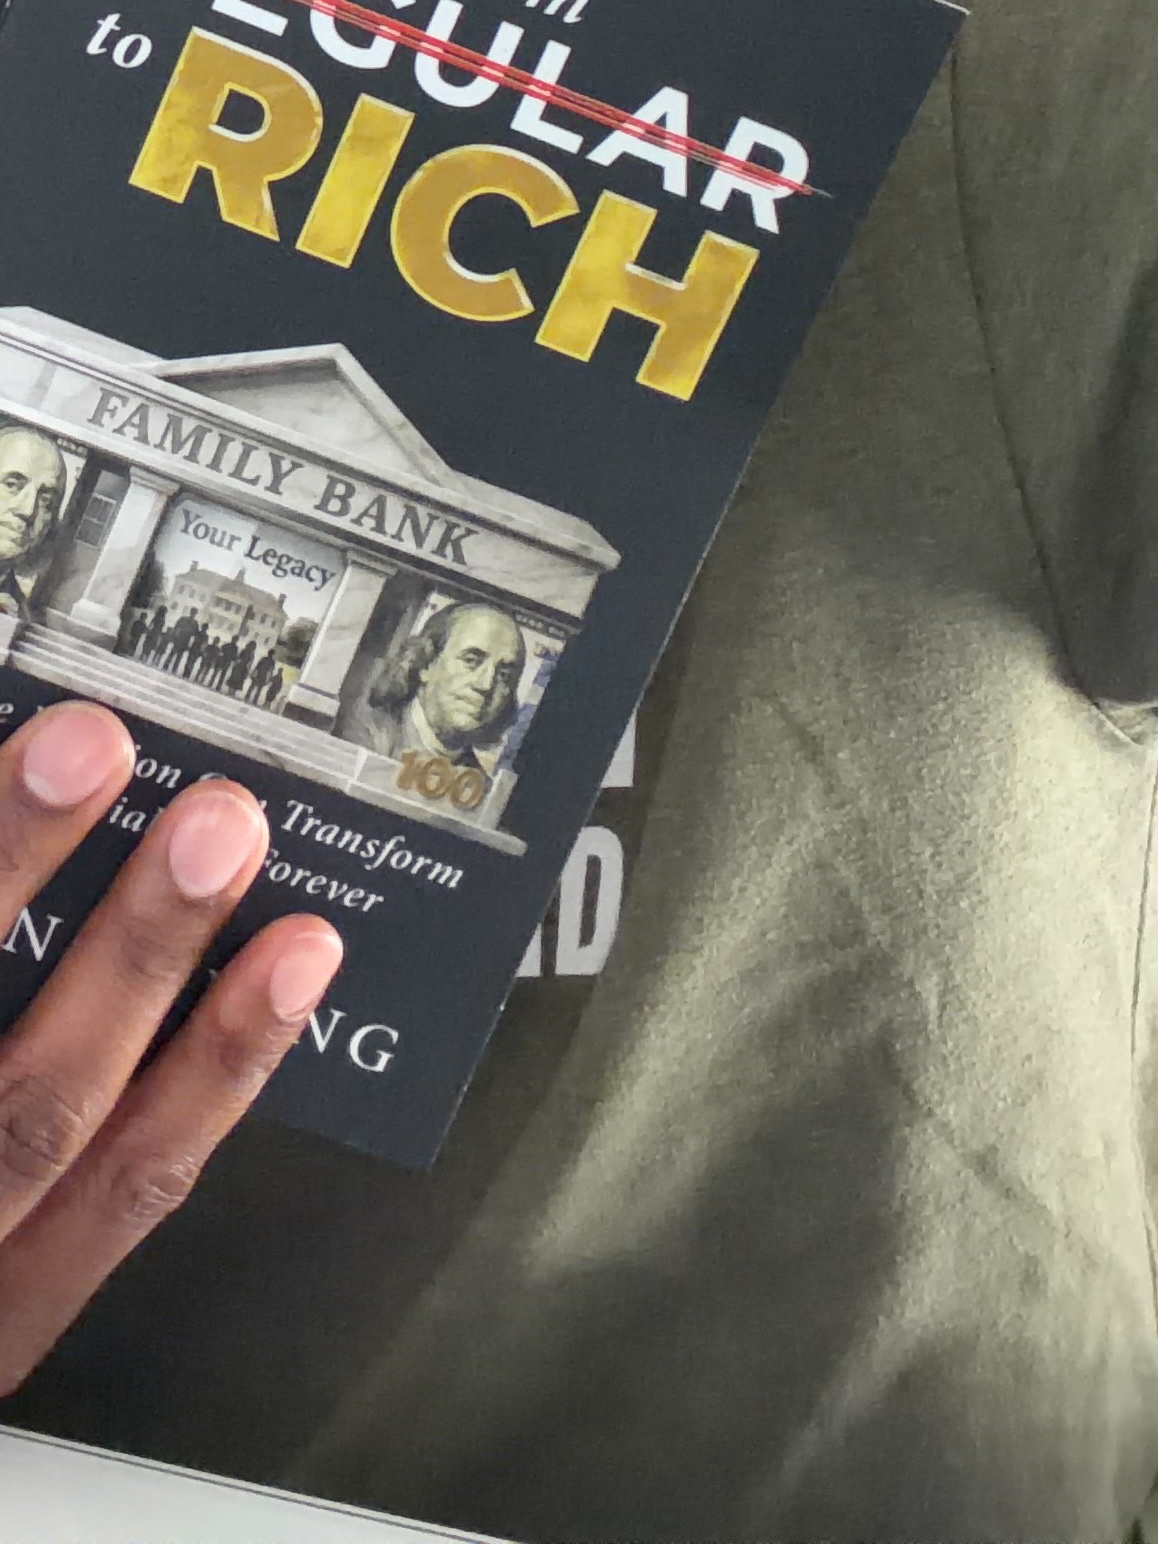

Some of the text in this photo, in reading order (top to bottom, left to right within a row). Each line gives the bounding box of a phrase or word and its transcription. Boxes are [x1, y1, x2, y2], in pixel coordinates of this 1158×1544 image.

[85, 10, 760, 402] to RICH
[87, 386, 480, 566] FAMILY BANK
[179, 509, 337, 592] Your Legacy
[396, 749, 487, 811] 100
[281, 799, 466, 890] Transform
